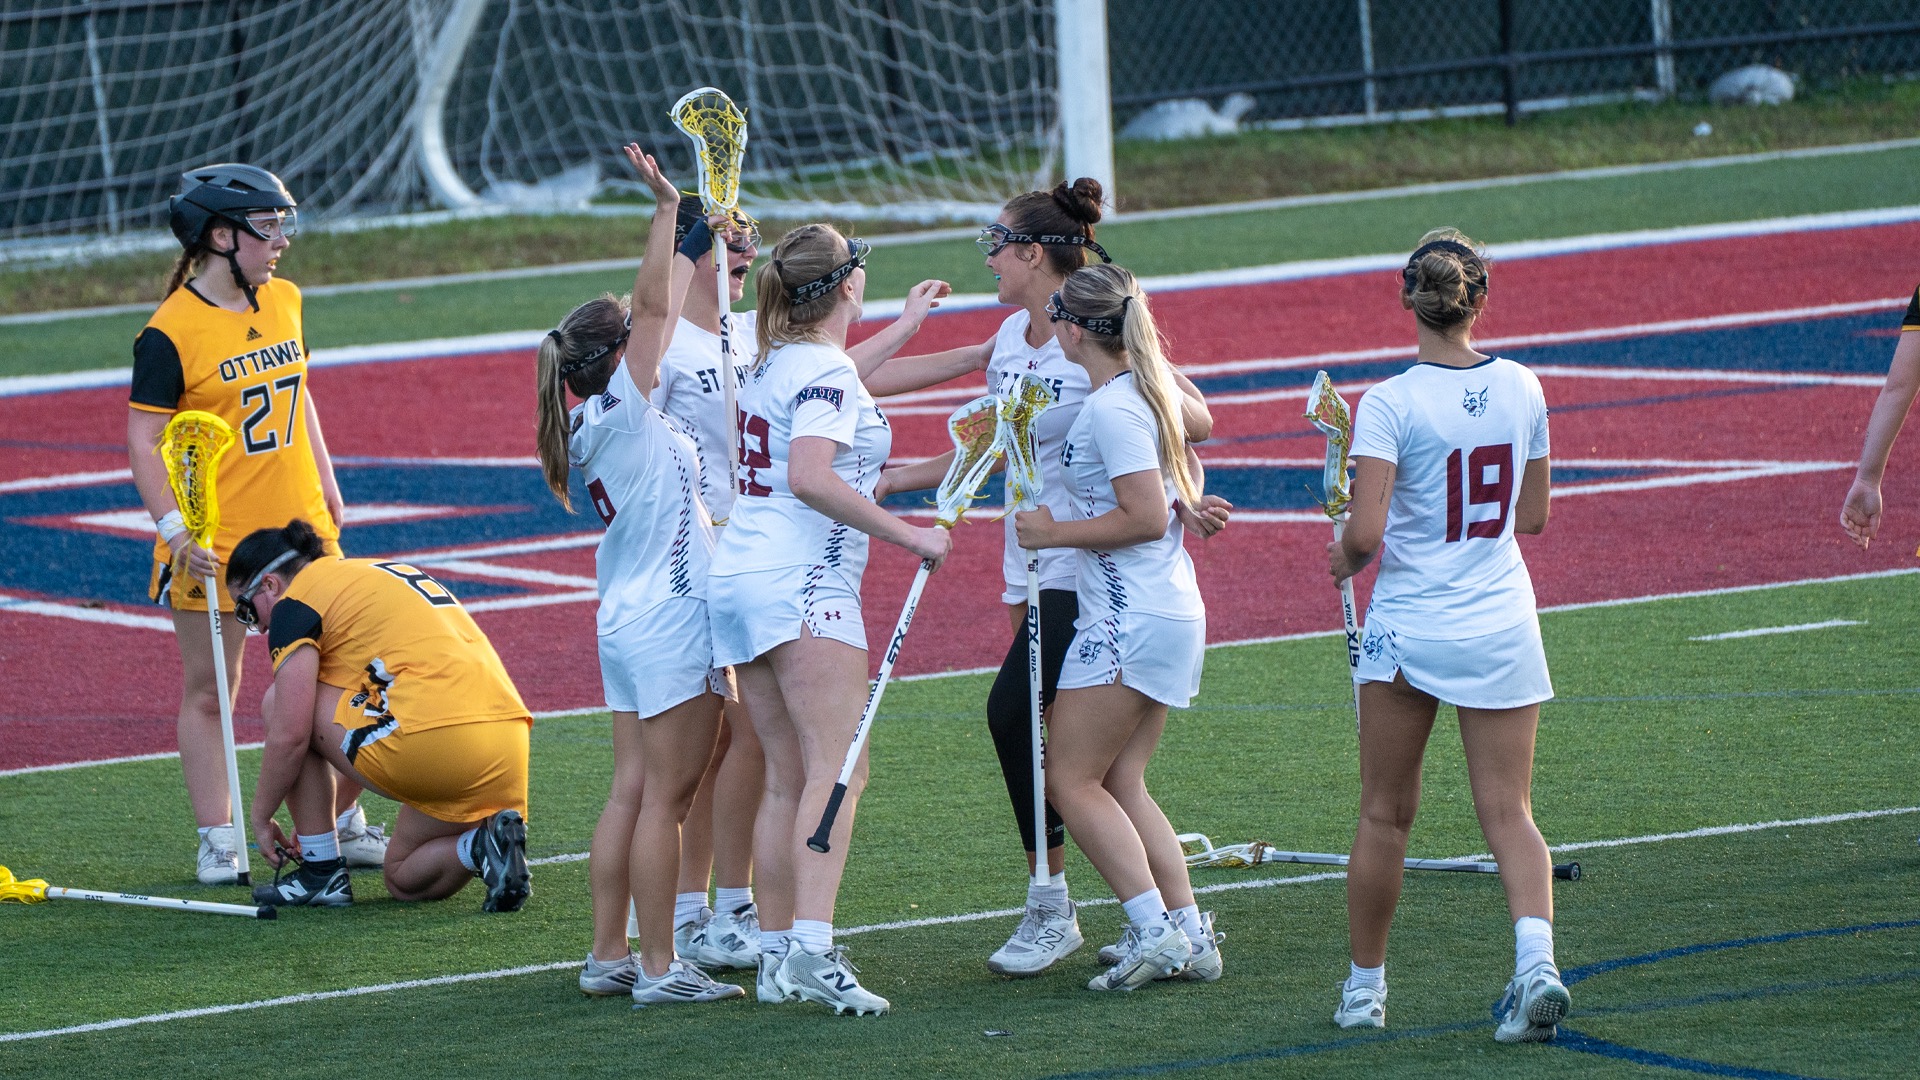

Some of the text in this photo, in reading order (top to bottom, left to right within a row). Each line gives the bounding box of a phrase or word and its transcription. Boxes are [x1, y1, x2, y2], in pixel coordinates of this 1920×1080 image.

[1008, 233, 1033, 242] STX
[1041, 234, 1066, 243] STX
[832, 261, 853, 280] STX
[796, 278, 826, 295] STX
[1060, 310, 1081, 324] STX
[1087, 318, 1113, 327] STX
[218, 338, 304, 383] OTTAWA
[795, 386, 844, 412] NAIA
[240, 372, 302, 456] 27
[1445, 442, 1514, 543] 19
[368, 561, 460, 608] 8
[903, 606, 916, 629] ARIA
[1028, 604, 1040, 646] STX
[1345, 602, 1354, 627] ARIA
[886, 627, 907, 666] STX
[84, 893, 104, 902] GAIT
